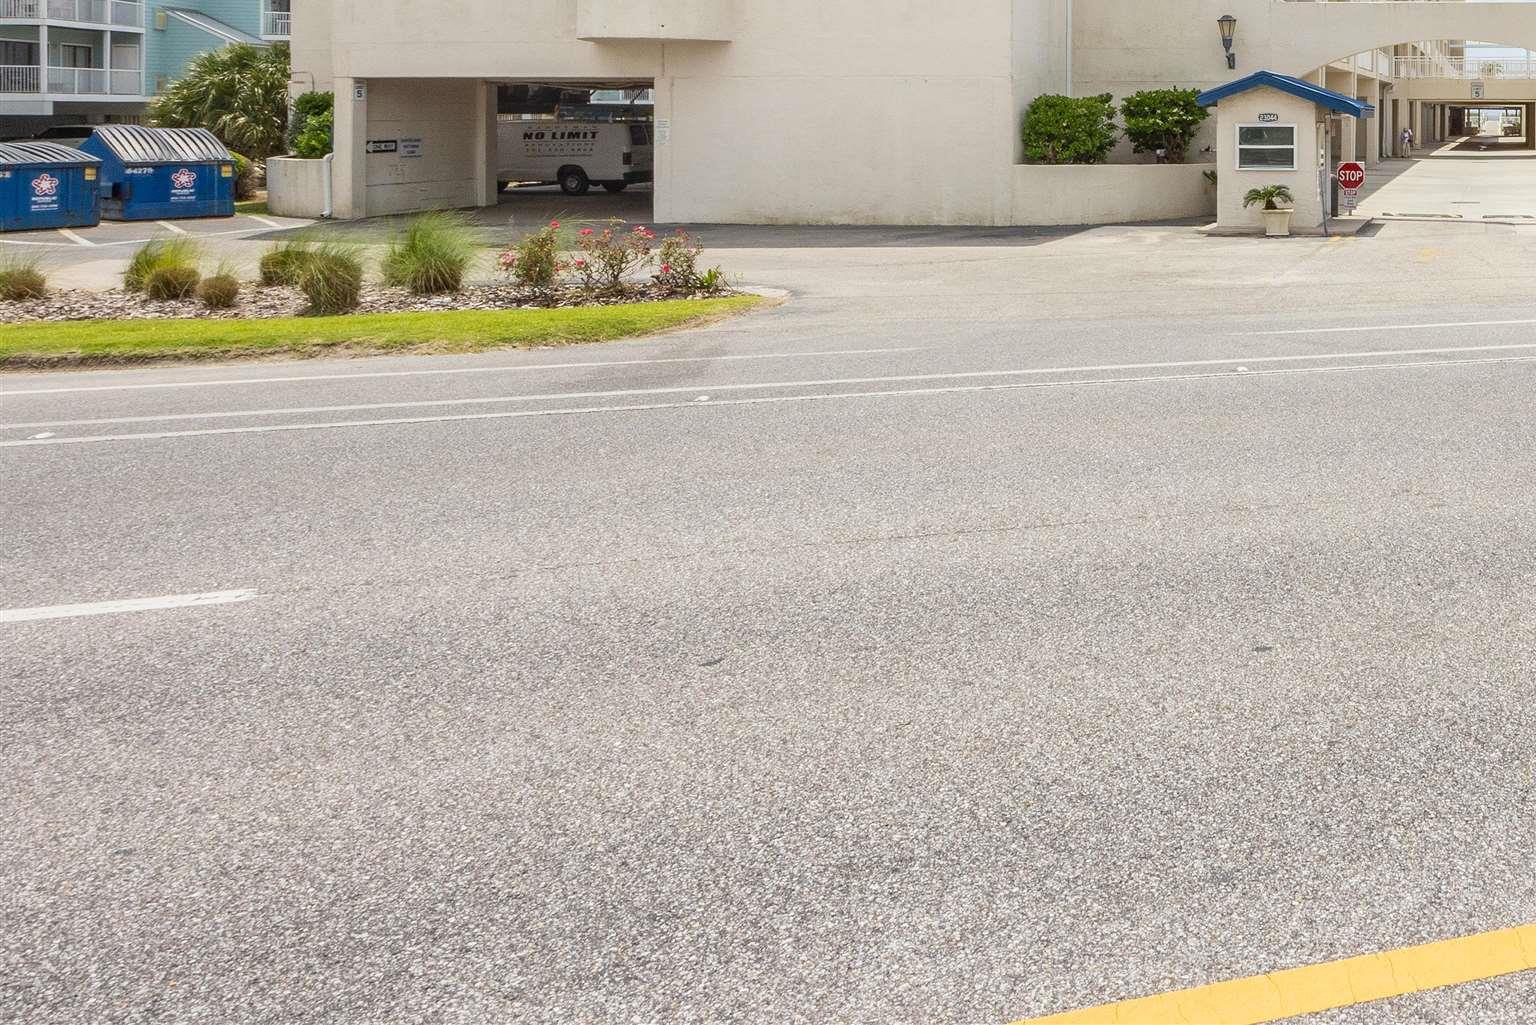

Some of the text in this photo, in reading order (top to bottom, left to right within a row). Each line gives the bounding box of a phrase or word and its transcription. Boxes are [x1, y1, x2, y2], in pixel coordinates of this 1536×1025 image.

[523, 131, 599, 140] NO LIMIT
[1339, 170, 1362, 180] STOP
